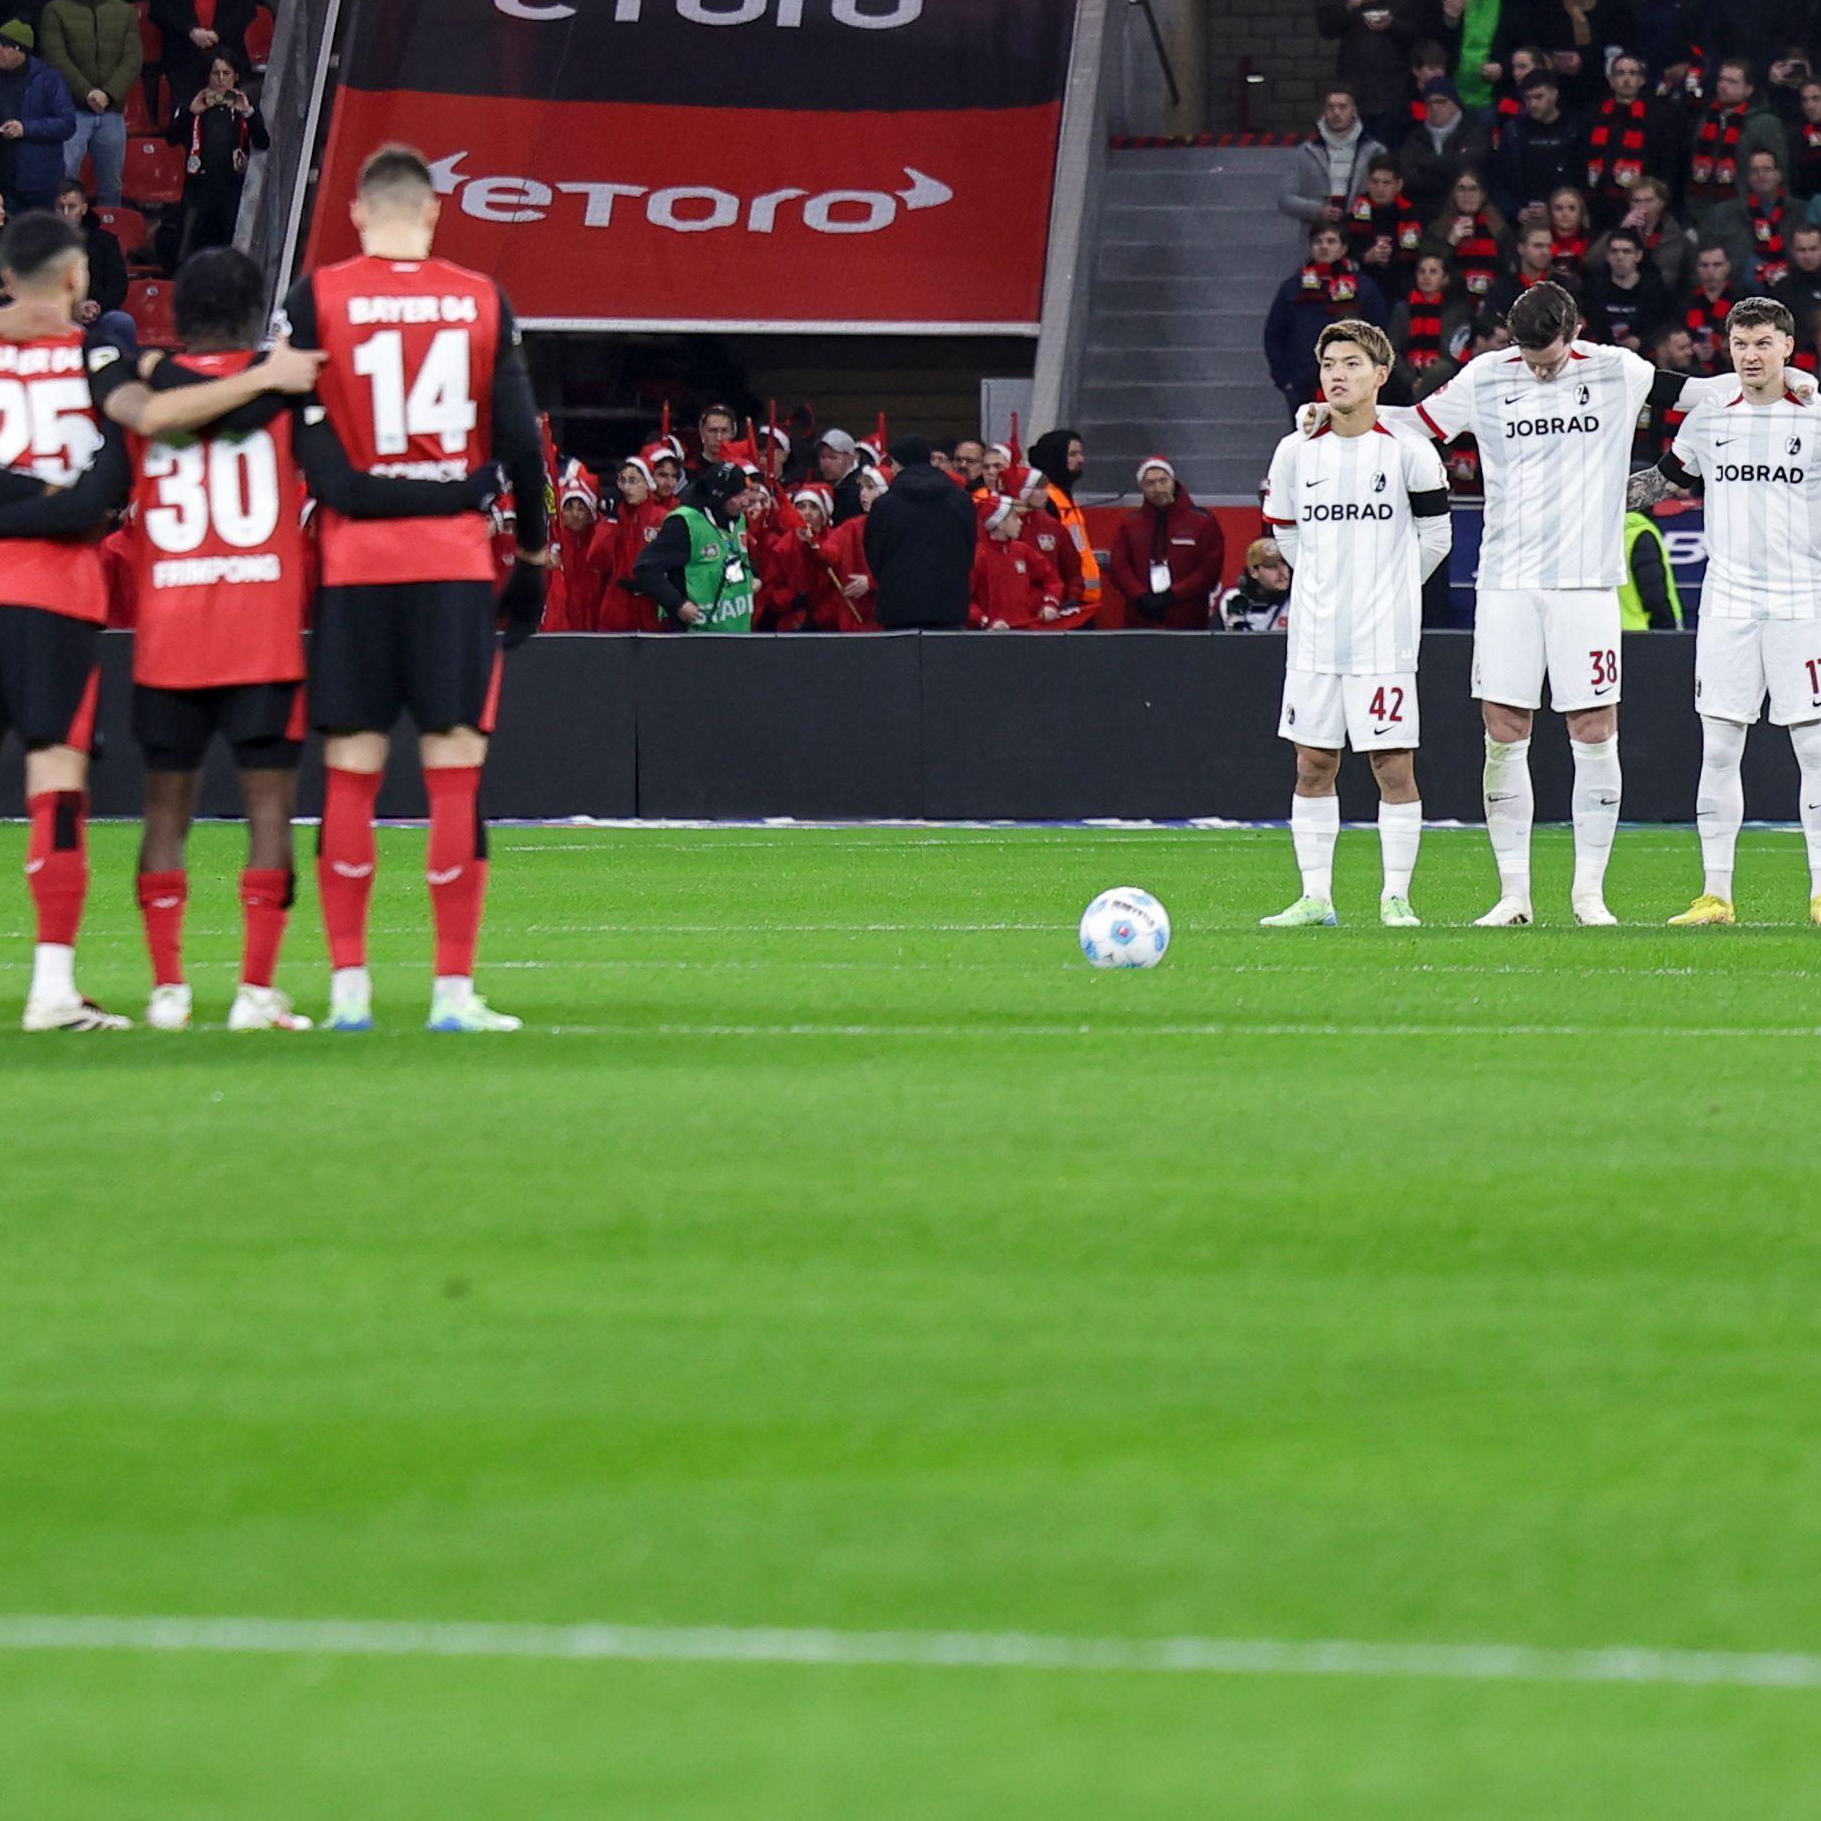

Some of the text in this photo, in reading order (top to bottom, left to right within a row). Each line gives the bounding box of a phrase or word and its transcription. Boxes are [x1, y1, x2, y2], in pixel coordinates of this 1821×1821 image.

[353, 329, 478, 456] 14
[1505, 415, 1600, 440] JOBRAD
[141, 429, 281, 554] 30
[1714, 464, 1804, 485] JOBRAD
[1301, 503, 1394, 523] JOBRAD
[1589, 649, 1618, 686] 38
[1369, 686, 1403, 723] 42
